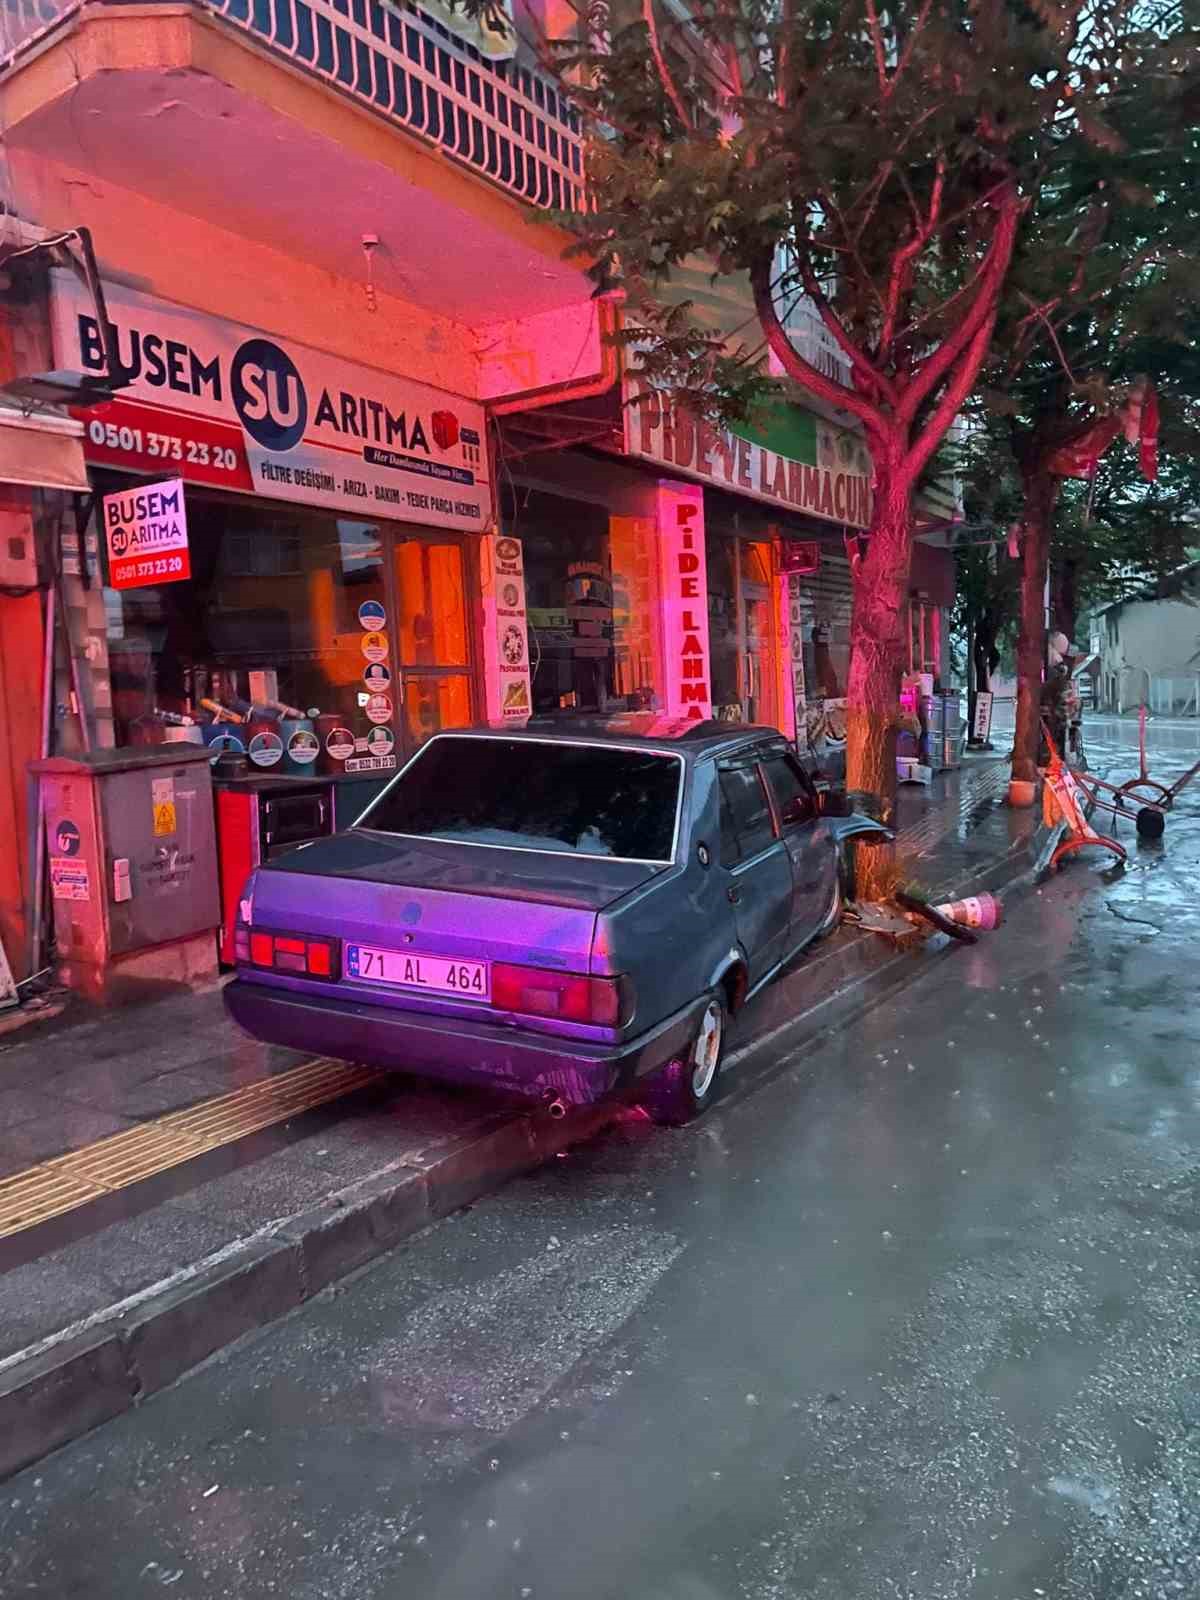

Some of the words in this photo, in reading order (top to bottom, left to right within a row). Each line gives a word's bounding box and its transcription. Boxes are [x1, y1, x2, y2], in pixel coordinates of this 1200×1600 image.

[78, 313, 222, 401] BUSEM
[241, 363, 299, 427] SU
[314, 388, 431, 454] ARITMA
[89, 420, 142, 453] 0501
[147, 431, 183, 460] 373
[186, 440, 210, 465] 23
[212, 446, 237, 471] 20
[260, 460, 293, 484] FİLTRE
[343, 479, 368, 498] ARIZA
[375, 485, 400, 504] BAKIM
[406, 491, 430, 510] YEDEK
[760, 447, 870, 528] LAHMACUN
[107, 489, 180, 527] BUSEM
[112, 532, 128, 551] SU
[130, 521, 182, 545] ARITMA
[115, 565, 136, 581] 0501
[137, 562, 154, 576] 373
[156, 560, 168, 574] 23
[169, 557, 183, 572] 20
[363, 952, 384, 977] 71
[404, 959, 427, 983] AL
[446, 965, 482, 991] 464
